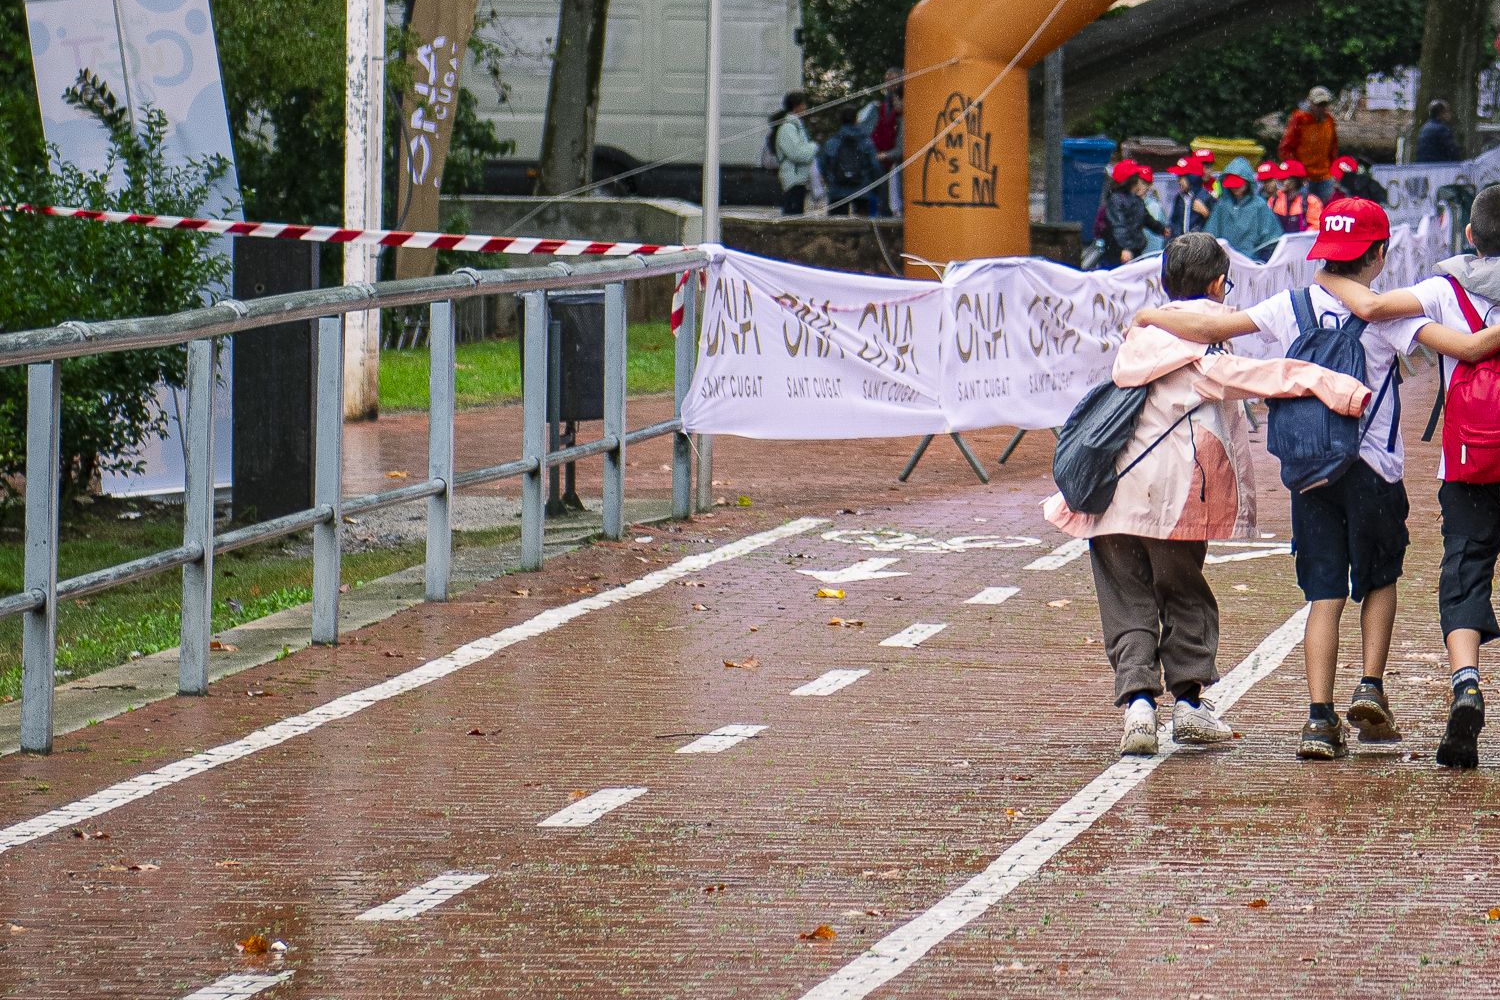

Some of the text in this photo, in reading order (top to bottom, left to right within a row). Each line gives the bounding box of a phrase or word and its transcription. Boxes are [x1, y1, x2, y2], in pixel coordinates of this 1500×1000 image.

[1325, 215, 1356, 233] TOT
[706, 277, 762, 358] ONA
[955, 292, 1010, 364] ONA
[701, 376, 763, 400] SANT CUGAT
[787, 377, 842, 400] SANT CUGAT
[862, 379, 885, 401] SANT
[958, 376, 1011, 402] SANT CUGAT
